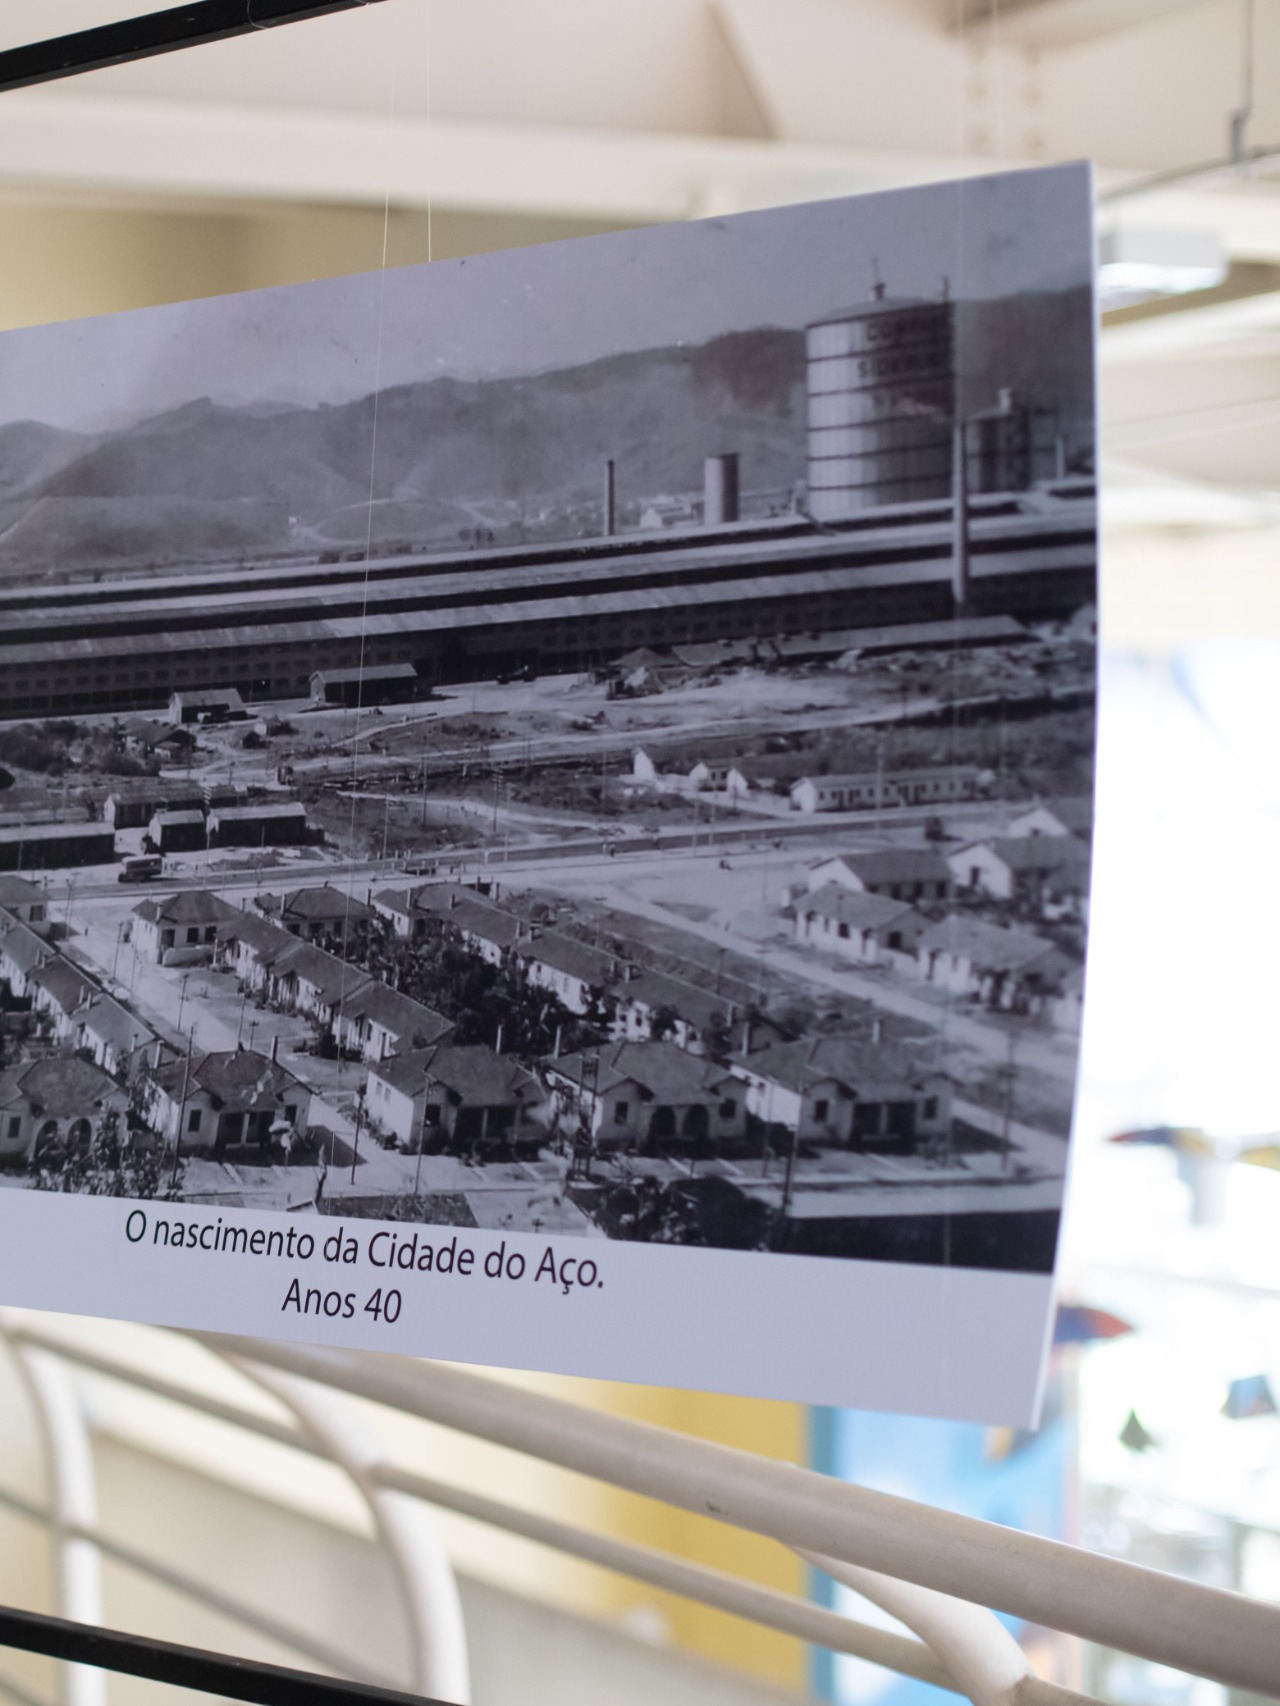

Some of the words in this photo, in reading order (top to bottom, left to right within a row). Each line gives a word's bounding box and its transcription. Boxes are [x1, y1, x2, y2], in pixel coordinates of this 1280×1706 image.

[125, 1208, 147, 1243] O
[153, 1217, 315, 1260] nascimento
[323, 1226, 359, 1265] da
[368, 1231, 475, 1276] Cidade
[483, 1240, 526, 1281] do
[534, 1246, 605, 1296] Aço.
[281, 1278, 357, 1319] Anos
[363, 1288, 403, 1324] 40
